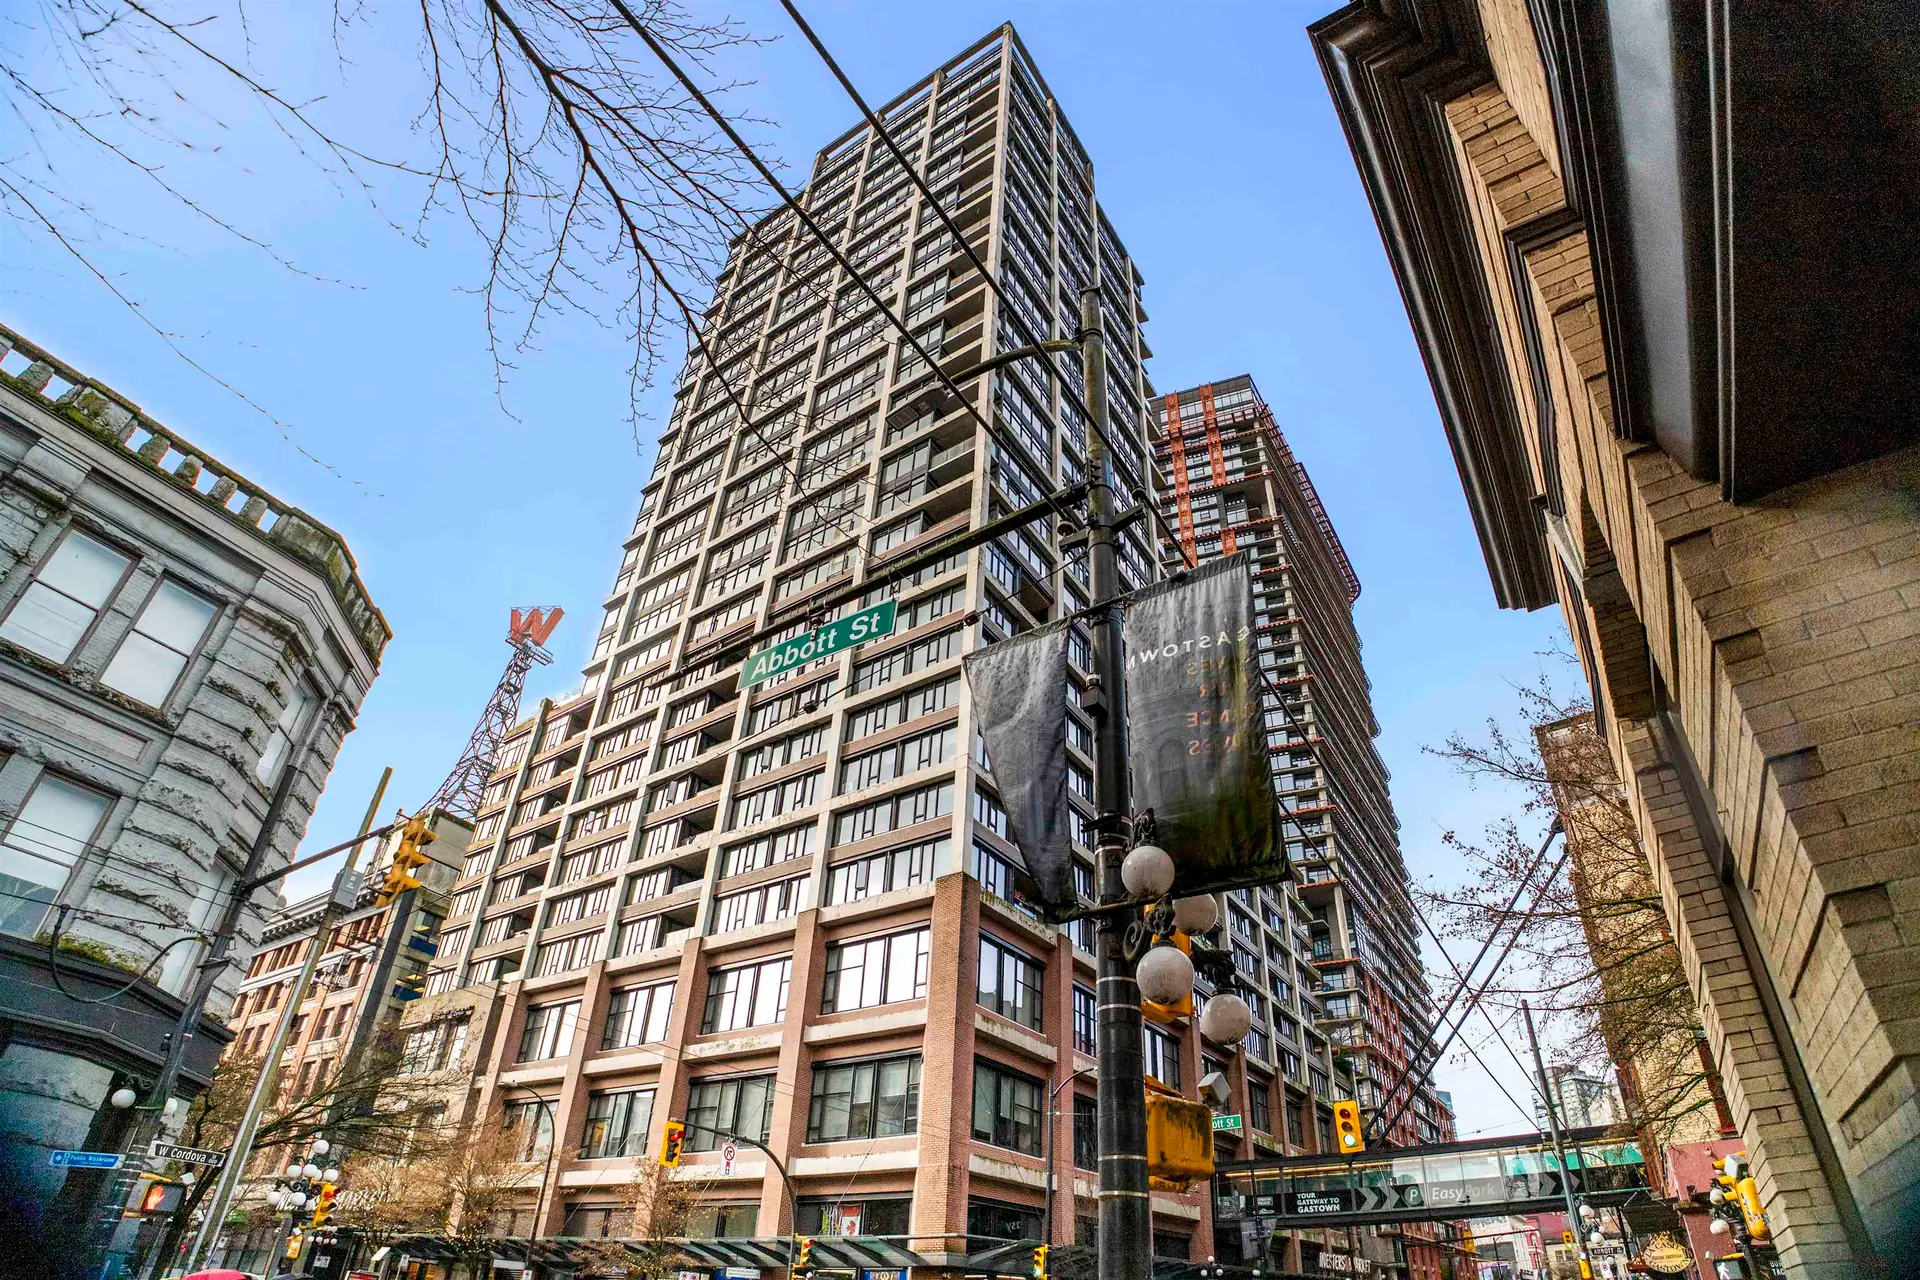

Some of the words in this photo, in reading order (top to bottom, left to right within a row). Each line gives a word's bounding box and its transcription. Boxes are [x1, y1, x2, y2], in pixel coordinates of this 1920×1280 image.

[511, 607, 564, 646] W
[750, 628, 837, 680] Abbott
[849, 612, 881, 641] St
[1212, 1119, 1224, 1129] ott
[1226, 1117, 1235, 1128] St
[159, 1145, 170, 1157] W
[171, 1147, 207, 1163] Cordova
[1296, 1197, 1328, 1206] GATEWAY
[1409, 1189, 1418, 1202] P
[1297, 1203, 1341, 1214] GASTOWN
[1649, 1259, 1690, 1272] GASTOWN
